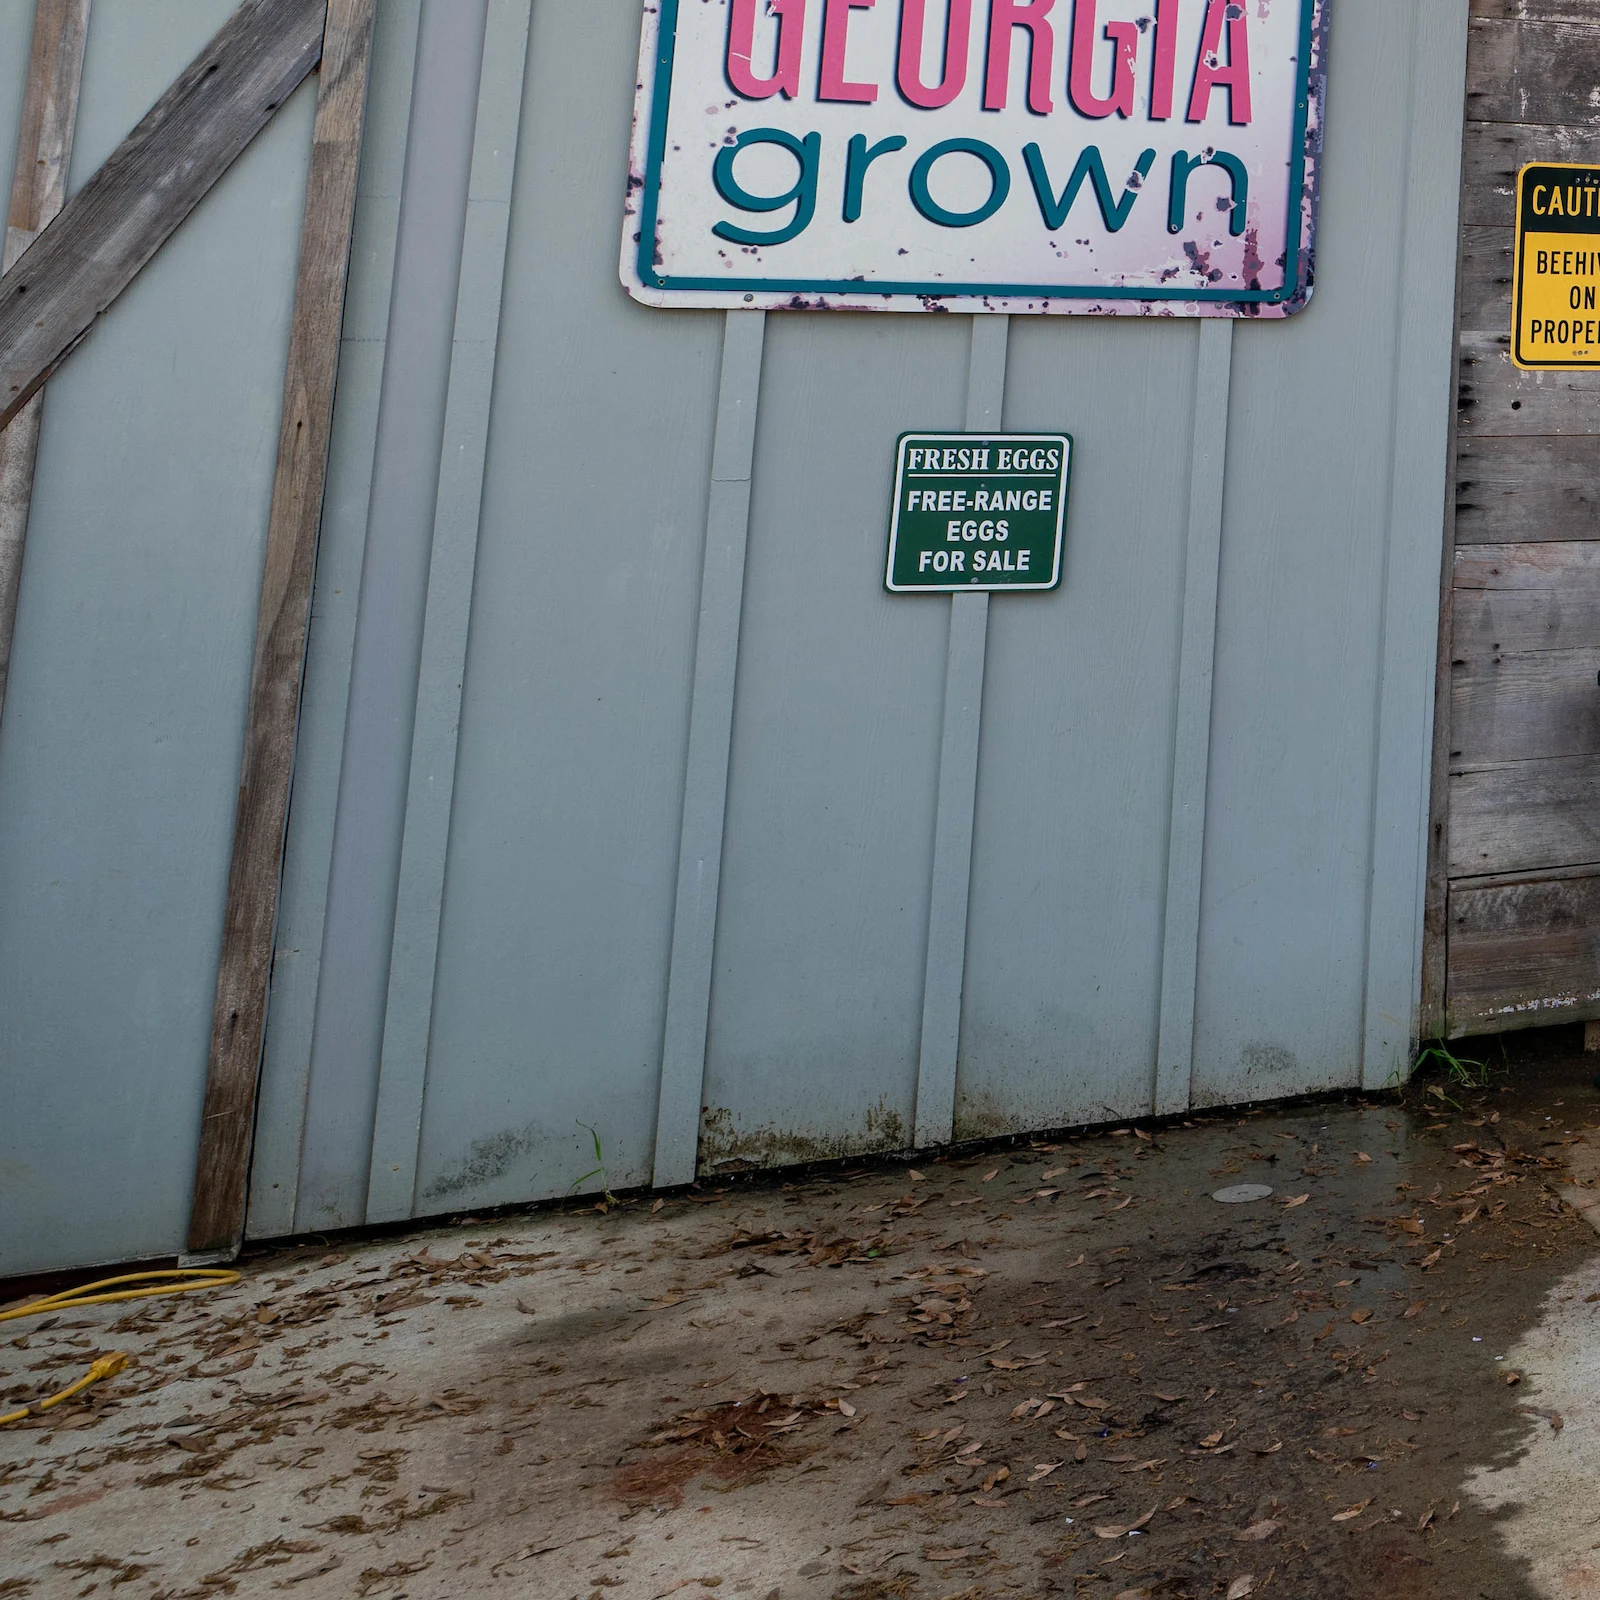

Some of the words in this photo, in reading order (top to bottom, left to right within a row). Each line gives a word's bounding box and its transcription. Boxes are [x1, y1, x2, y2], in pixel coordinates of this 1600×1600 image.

[712, 126, 1250, 246] grown
[1570, 286, 1595, 309] ON
[907, 448, 989, 470] FRESH
[997, 449, 1059, 470] EGGS
[907, 490, 1052, 511] FREE-RANGE
[947, 520, 1009, 541] EGGS
[919, 551, 965, 571] FOR
[973, 550, 1030, 571] SALE
